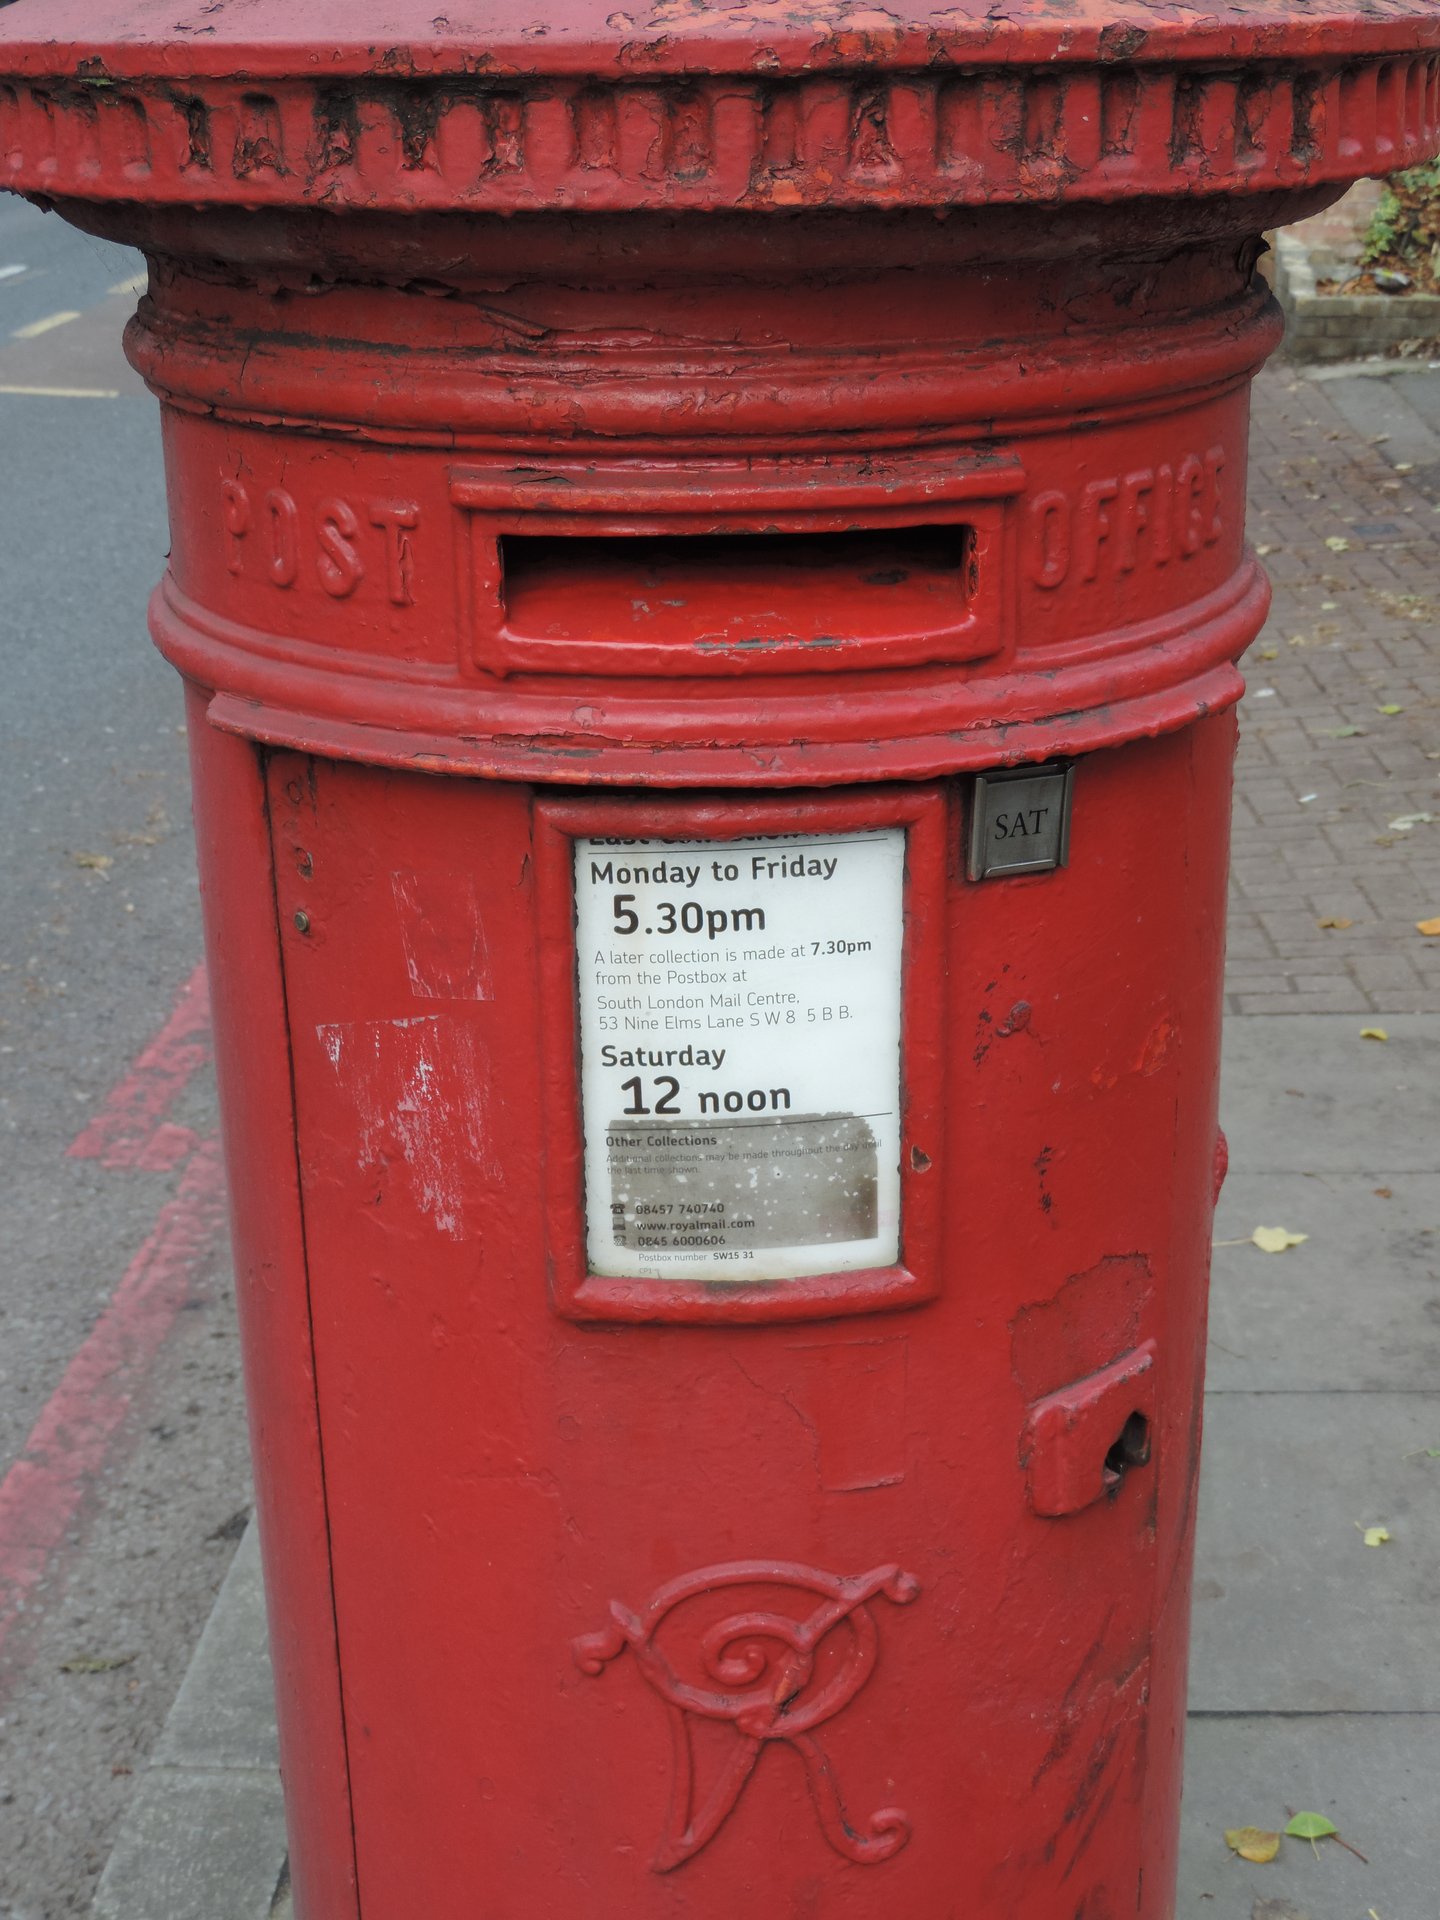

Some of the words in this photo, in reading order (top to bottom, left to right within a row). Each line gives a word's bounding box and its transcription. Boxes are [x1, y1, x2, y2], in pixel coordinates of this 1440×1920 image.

[221, 478, 420, 607] POST
[1028, 446, 1226, 588] OFFICE
[994, 807, 1048, 840] SAT
[590, 861, 701, 888] Monday
[711, 861, 739, 881] to
[751, 854, 838, 880] Friday
[613, 894, 766, 940] 5.30pm
[594, 950, 606, 965] A
[609, 950, 644, 964] later
[649, 949, 720, 964] collection
[725, 948, 737, 962] is
[743, 945, 785, 961] made
[791, 945, 806, 957] at
[811, 939, 872, 956] 7.30pm
[596, 971, 631, 985] from
[637, 971, 661, 985] the
[667, 970, 727, 984] Postbox
[732, 969, 748, 982] at
[597, 995, 642, 1010] South
[648, 994, 704, 1010] London
[710, 993, 741, 1008] Mail
[599, 1016, 618, 1031] 53
[624, 1016, 659, 1030] Nine
[665, 1015, 701, 1030] Elms
[707, 1014, 744, 1029] Lane
[601, 1044, 726, 1071] Saturday
[621, 1075, 681, 1115] 12
[698, 1087, 791, 1114] noon
[606, 1136, 642, 1148] Other
[647, 1134, 718, 1147] Collections
[706, 1153, 724, 1163] may
[729, 1151, 739, 1161] be
[742, 1150, 769, 1160] made
[772, 1145, 823, 1157] throughout
[825, 1144, 841, 1153] the
[607, 1167, 622, 1175] the
[625, 1165, 641, 1175] last
[644, 1165, 666, 1175] time
[636, 1204, 674, 1215] 08457
[679, 1203, 725, 1214] 740740
[636, 1219, 756, 1232] www.royalmail.com
[638, 1236, 668, 1247] 0845
[672, 1235, 726, 1247] 6000606
[638, 1252, 672, 1262] Postbox
[674, 1253, 708, 1261] number
[713, 1251, 740, 1261] SW15
[742, 1251, 754, 1259] 31
